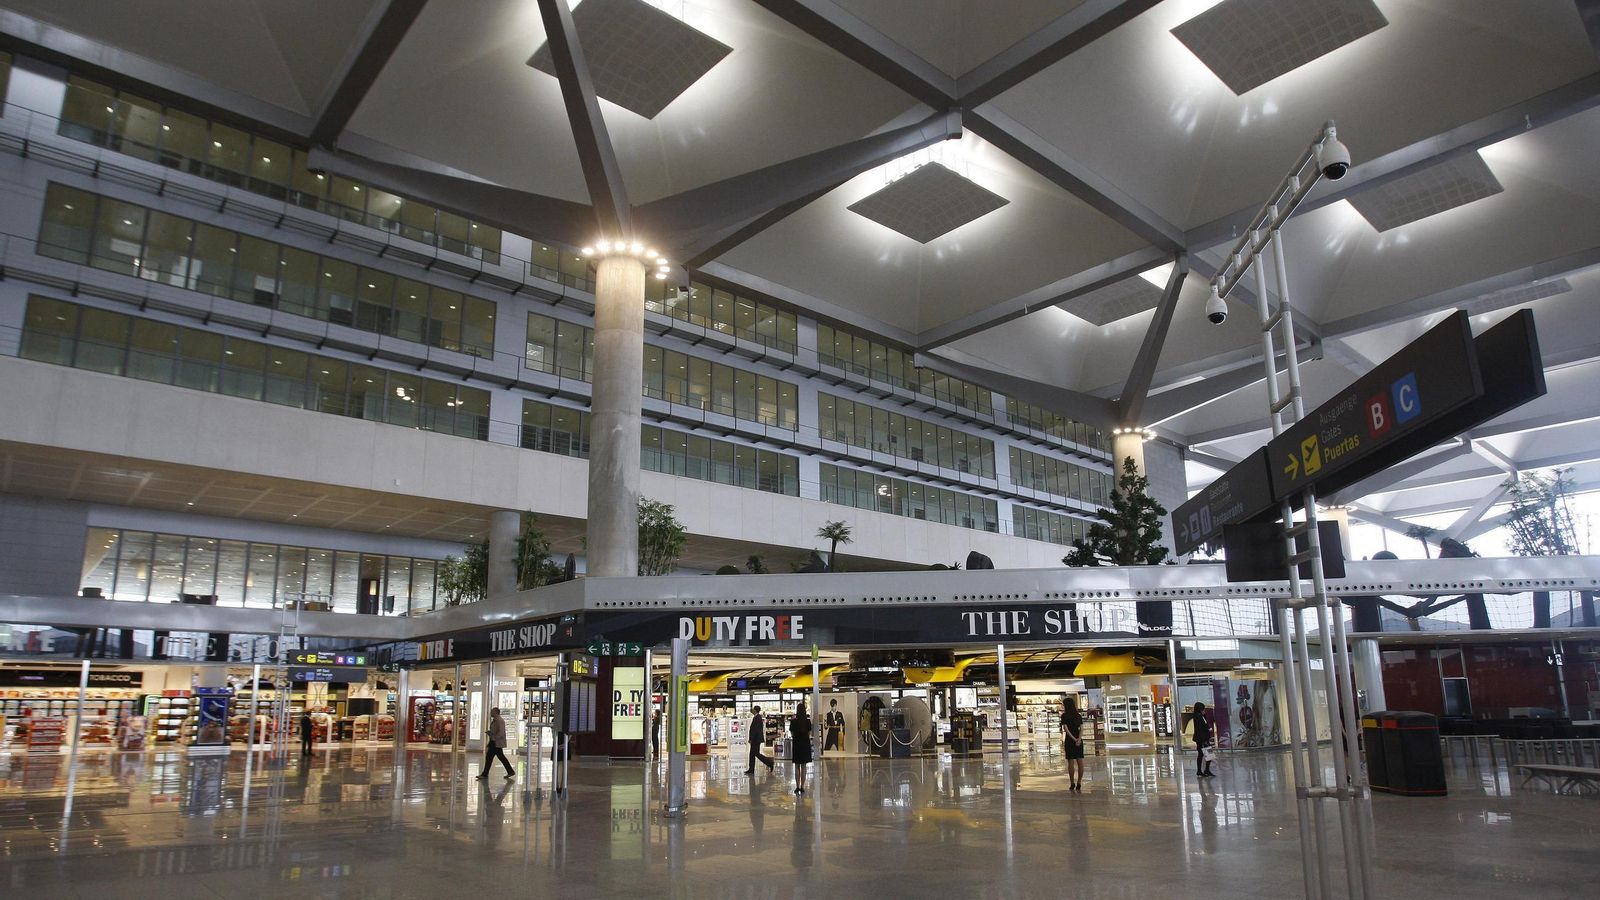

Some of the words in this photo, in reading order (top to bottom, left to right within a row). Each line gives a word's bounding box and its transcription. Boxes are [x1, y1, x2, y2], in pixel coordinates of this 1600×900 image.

[1319, 393, 1358, 427] Ausgaenge
[1371, 402, 1385, 431] B
[1399, 383, 1413, 413] C
[1321, 424, 1343, 445] Gates
[1324, 434, 1361, 464] Puertas
[679, 616, 740, 641] DUTY
[745, 615, 804, 641] FREE
[961, 610, 1031, 636] THE
[1044, 608, 1131, 635] SHOP
[490, 629, 516, 652] THE
[519, 623, 557, 649] SHOP
[89, 674, 131, 682] TOBACCO
[614, 704, 641, 717] FREE
